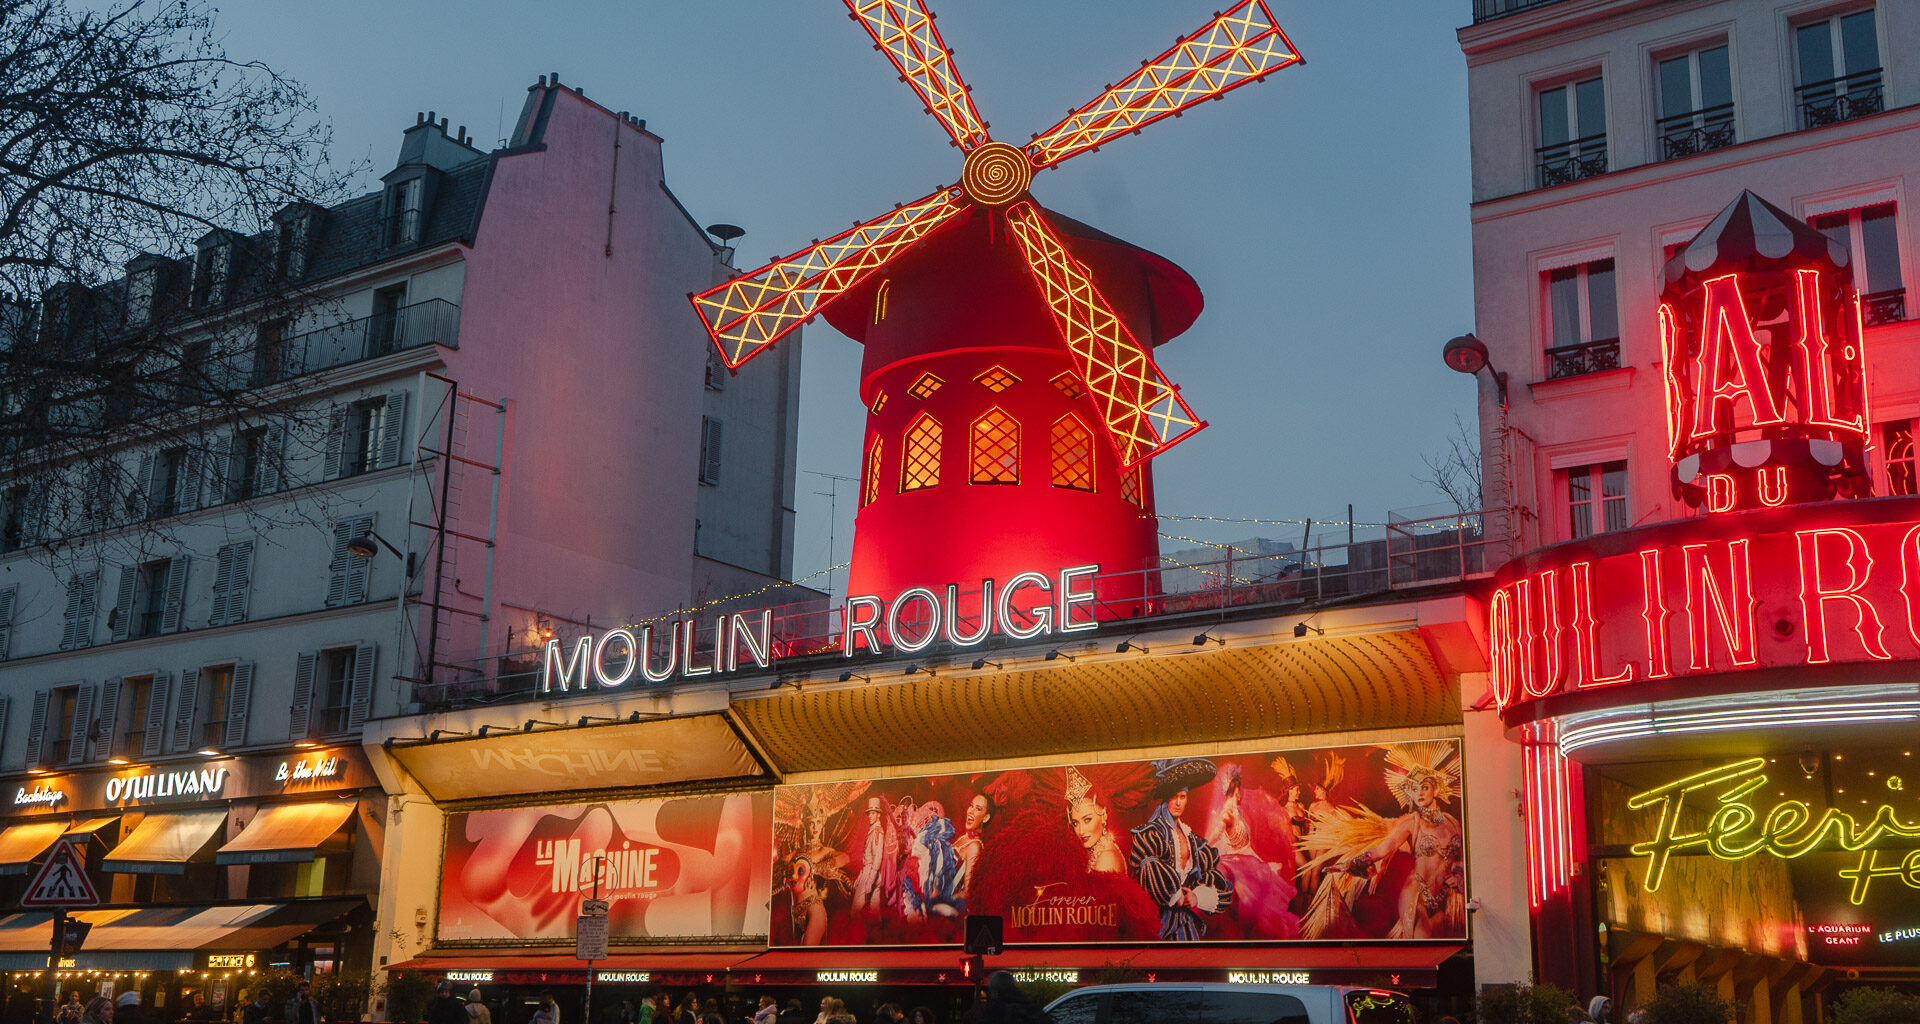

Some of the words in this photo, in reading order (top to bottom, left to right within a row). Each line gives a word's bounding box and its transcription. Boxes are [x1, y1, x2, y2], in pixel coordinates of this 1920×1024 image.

[543, 608, 773, 694] MOULIN
[843, 563, 1099, 658] ROUGE
[1490, 538, 1757, 708] OULIN
[292, 759, 312, 779] the
[105, 767, 227, 801] O'SULLIVANS
[14, 785, 63, 807] Backstage
[536, 841, 553, 860] LA
[1026, 881, 1097, 914] Forever
[1011, 905, 1064, 928] MOULIN
[1066, 903, 1117, 927] ROUGE
[1825, 936, 1860, 945] GEANT
[1879, 932, 1893, 943] LE
[446, 972, 471, 982] MOULIN
[471, 972, 493, 982] ROUGE
[598, 972, 624, 982] MOULIN
[625, 973, 650, 982] ROUGE
[816, 971, 848, 982] MOULIN
[849, 972, 878, 982] ROUGE
[1228, 972, 1270, 984] MOULIN
[1272, 972, 1310, 984] ROUGE
